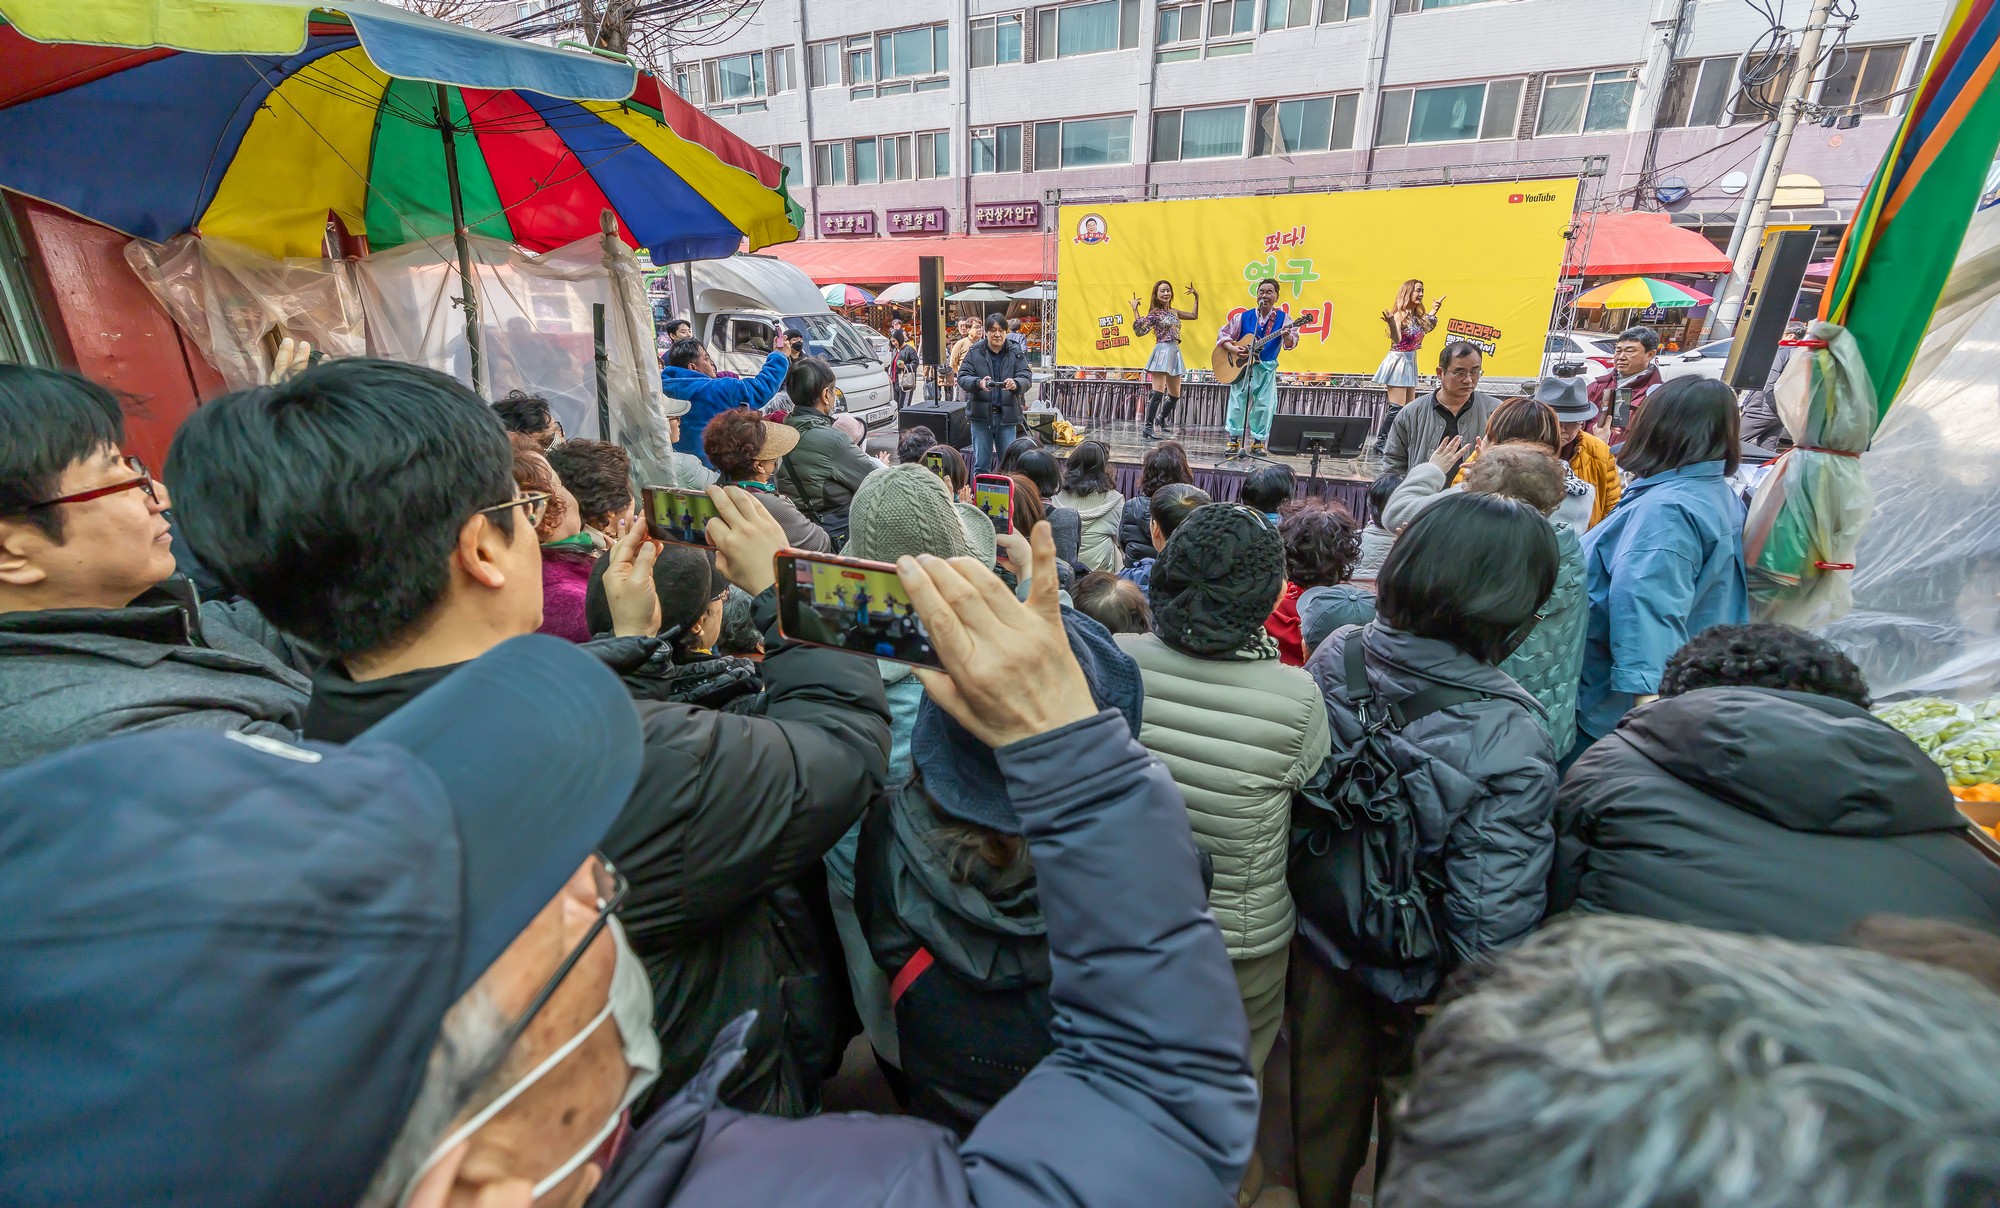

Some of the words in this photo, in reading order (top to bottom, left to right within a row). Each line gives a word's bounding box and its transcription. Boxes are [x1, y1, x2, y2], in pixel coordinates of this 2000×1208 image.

[1525, 193, 1556, 203] YouTube
[976, 207, 1014, 222] 유진상가
[1015, 206, 1034, 221] 입구
[825, 215, 865, 228] 충남상회
[1264, 225, 1306, 253] 떴다!
